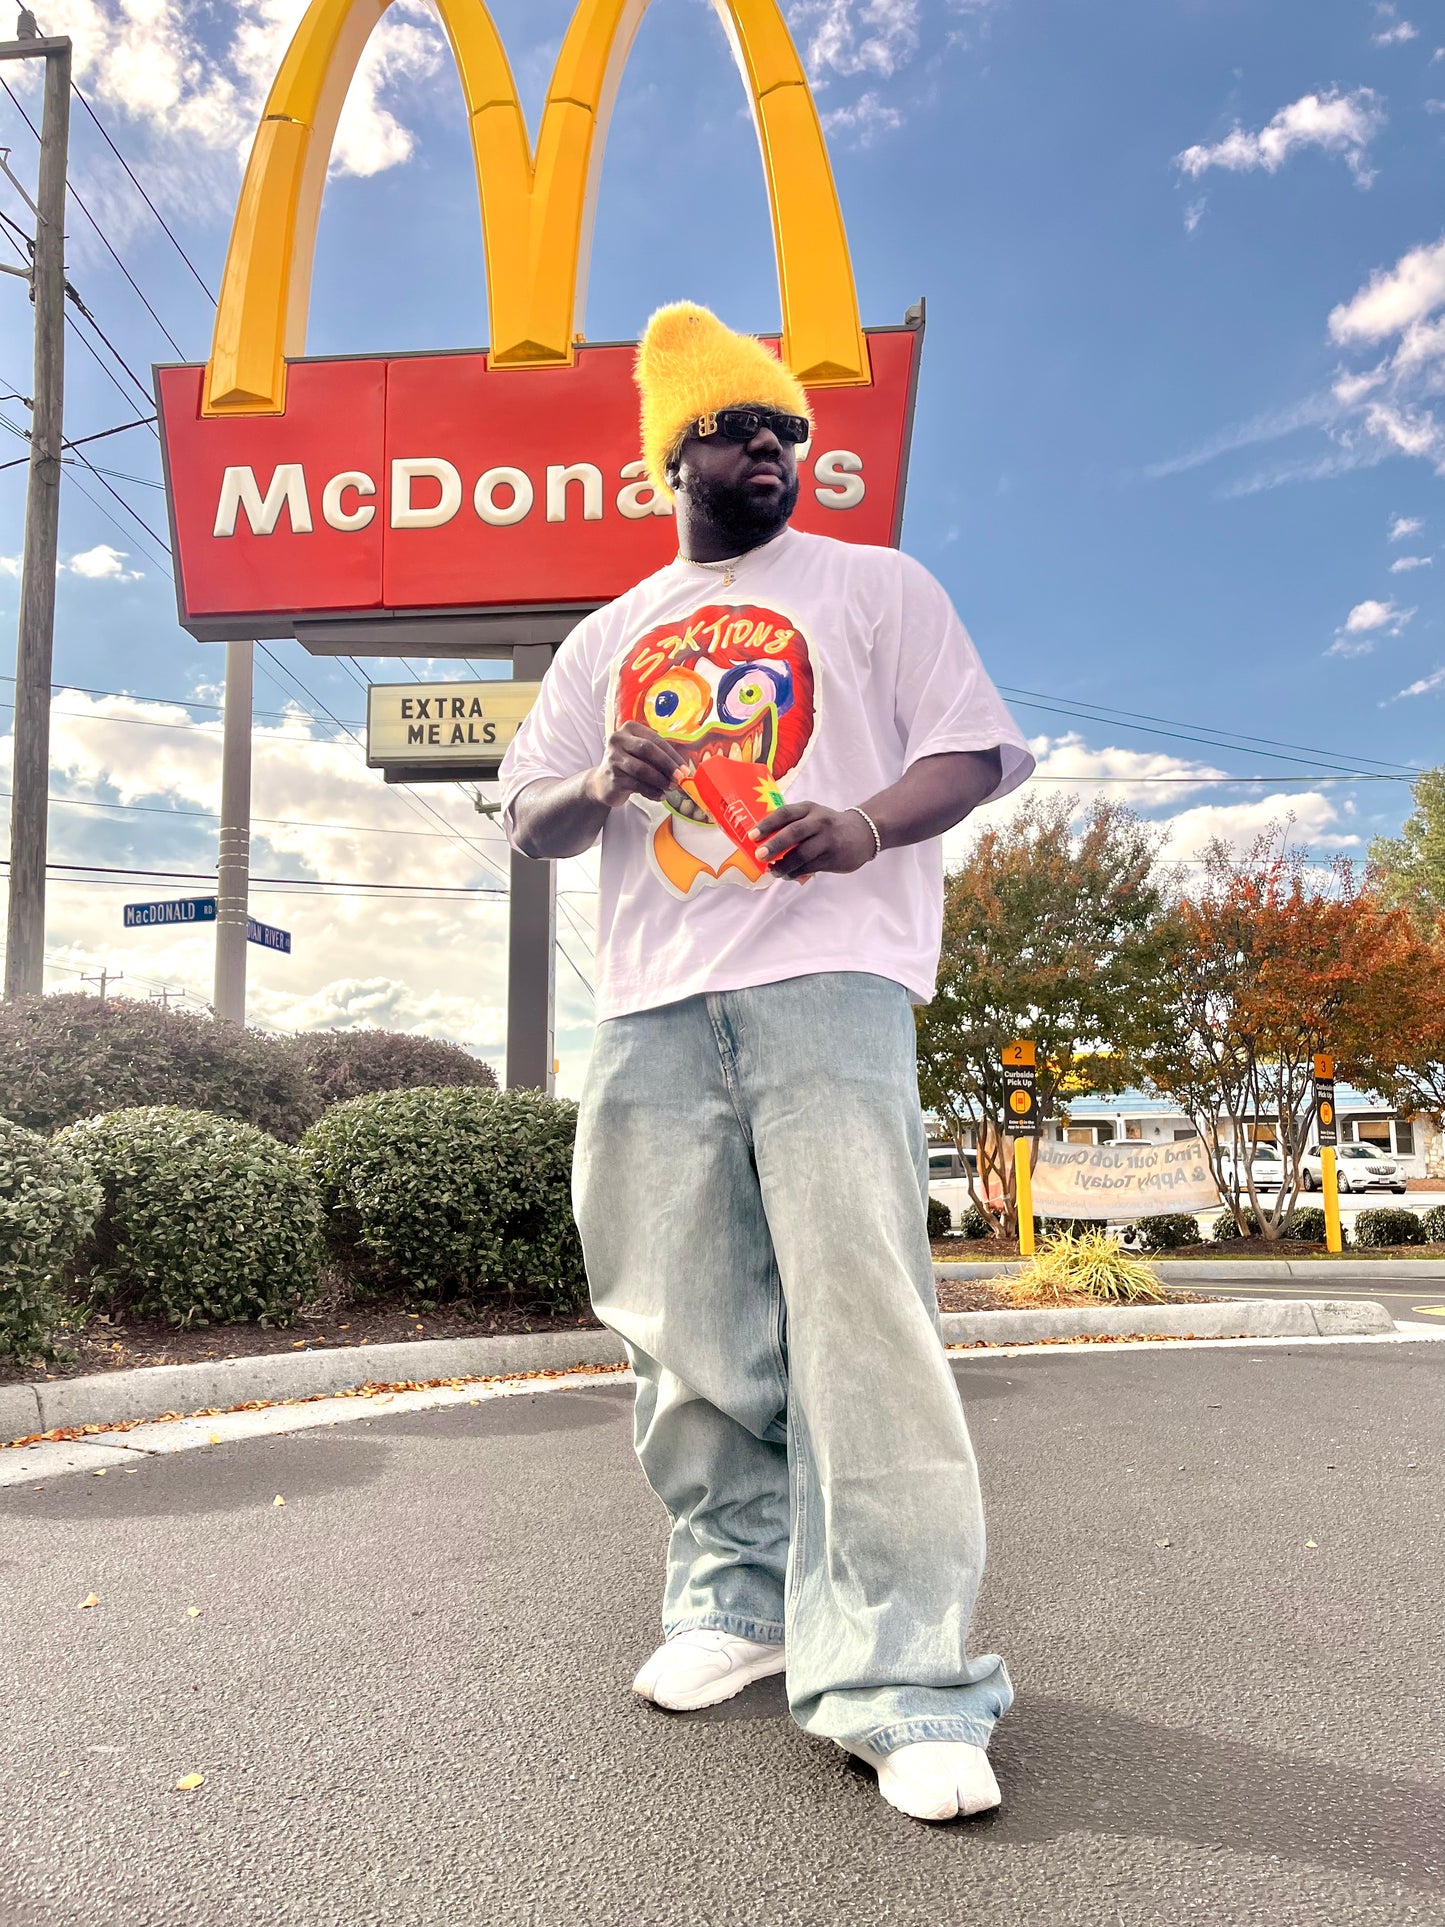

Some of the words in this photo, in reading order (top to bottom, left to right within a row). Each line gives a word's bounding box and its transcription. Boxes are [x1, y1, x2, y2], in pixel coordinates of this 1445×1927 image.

[212, 436, 867, 539] McDona's
[401, 697, 483, 719] EXTRA
[407, 722, 496, 745] MEALS
[126, 902, 196, 925] MacDONALD
[203, 905, 213, 915] RD
[247, 921, 262, 943] DIAN
[264, 927, 284, 949] RIVER
[1014, 1046, 1022, 1059] 2
[1320, 1061, 1326, 1072] 3
[1023, 1079, 1032, 1087] Up
